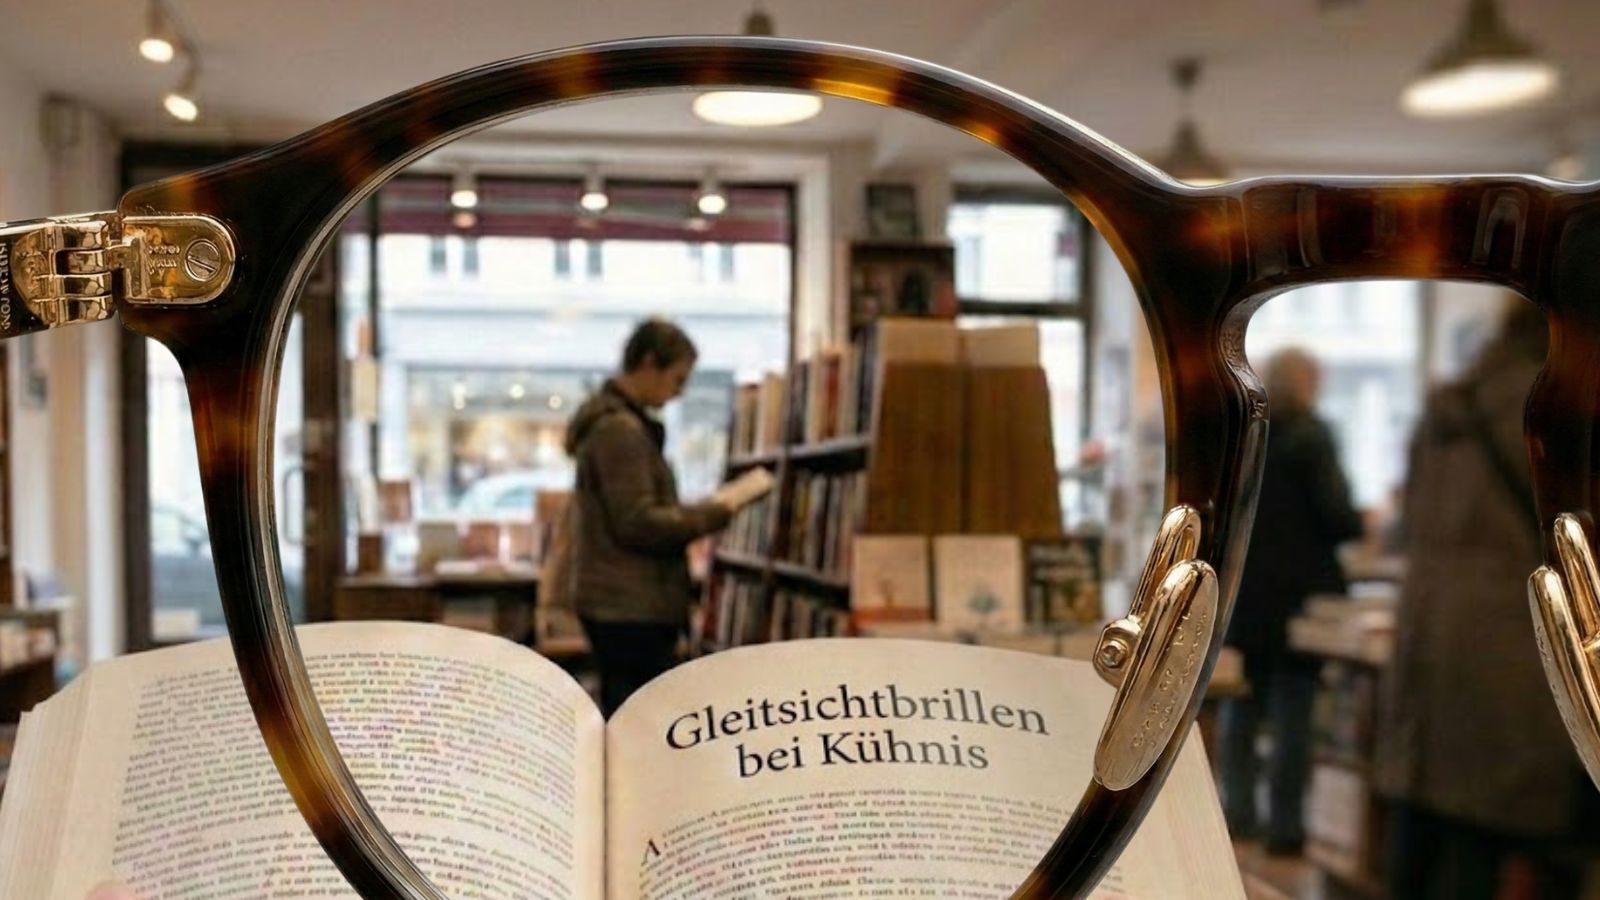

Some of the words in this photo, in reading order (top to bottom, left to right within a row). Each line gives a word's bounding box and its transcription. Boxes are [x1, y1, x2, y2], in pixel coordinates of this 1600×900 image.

[666, 684, 1049, 750] Gleitsichtbrillen
[736, 736, 803, 778] bei
[817, 729, 989, 770] Kühnis
